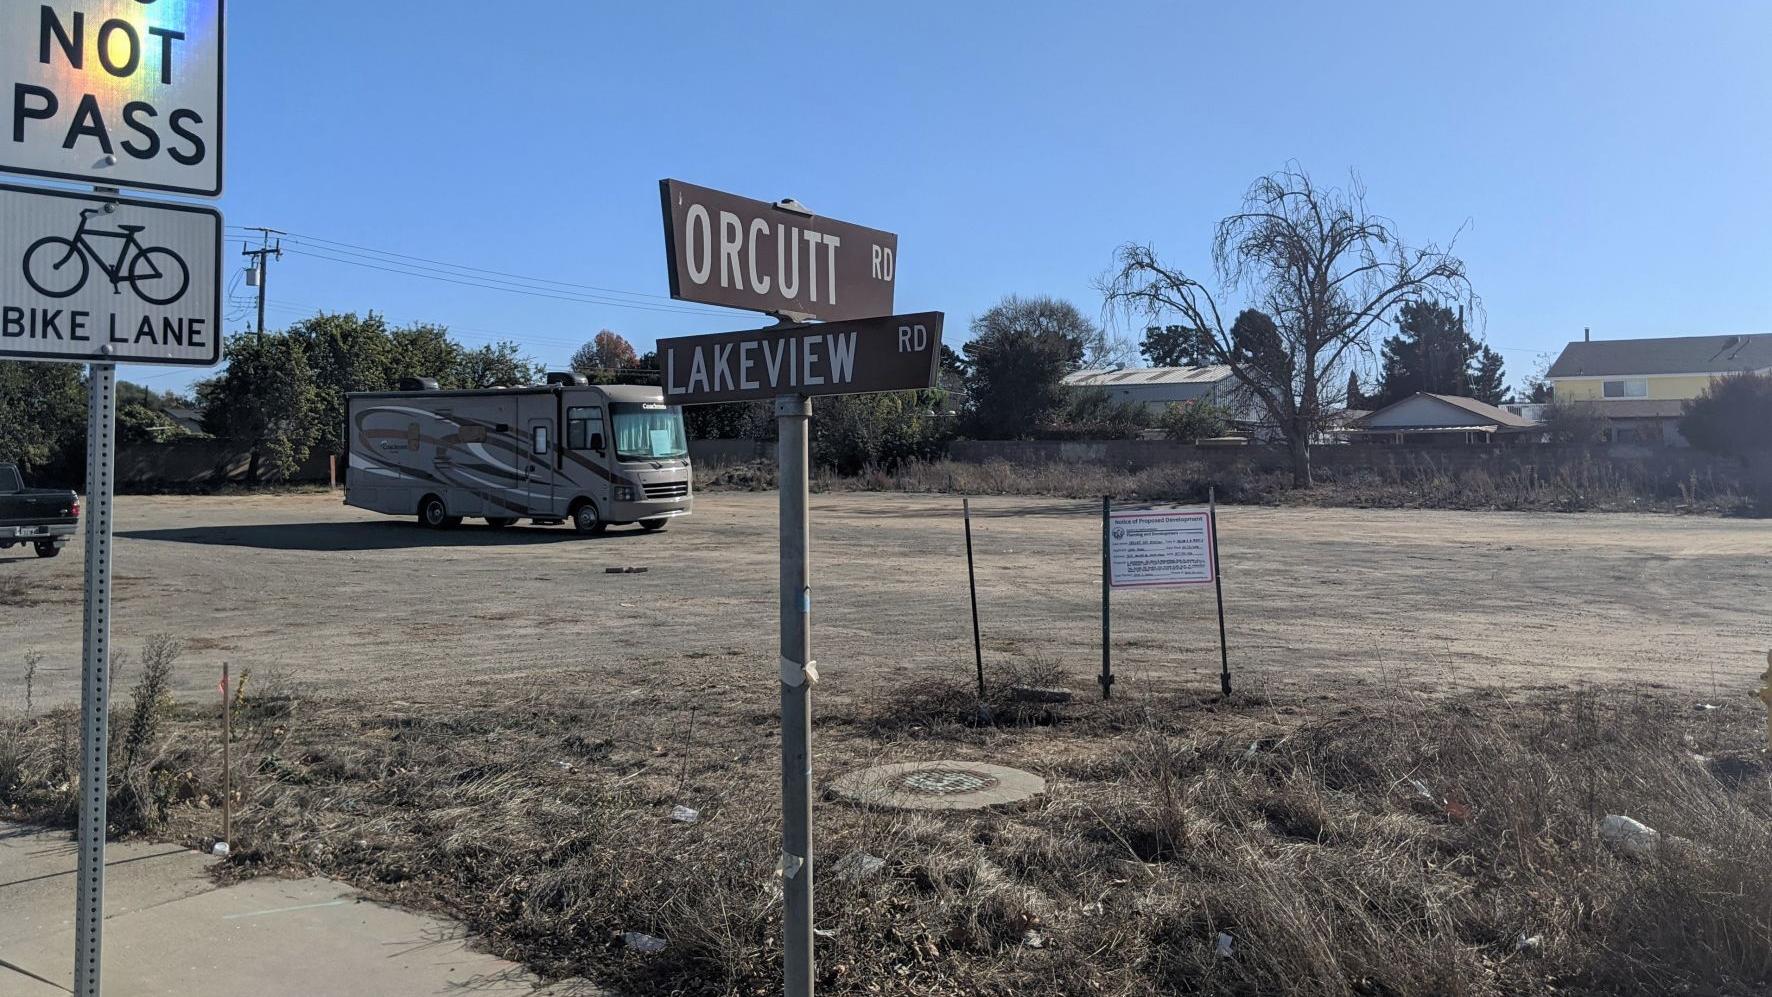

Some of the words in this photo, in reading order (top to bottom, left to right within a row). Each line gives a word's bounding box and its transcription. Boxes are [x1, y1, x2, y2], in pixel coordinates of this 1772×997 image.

[39, 5, 185, 85] NOT
[13, 83, 206, 166] PASS
[685, 204, 841, 306] ORCUTT
[872, 243, 893, 282] RD
[2, 306, 90, 341] BIKE
[109, 313, 206, 347] LANE
[667, 331, 857, 395] LAKEVIEW
[898, 324, 927, 353] RD
